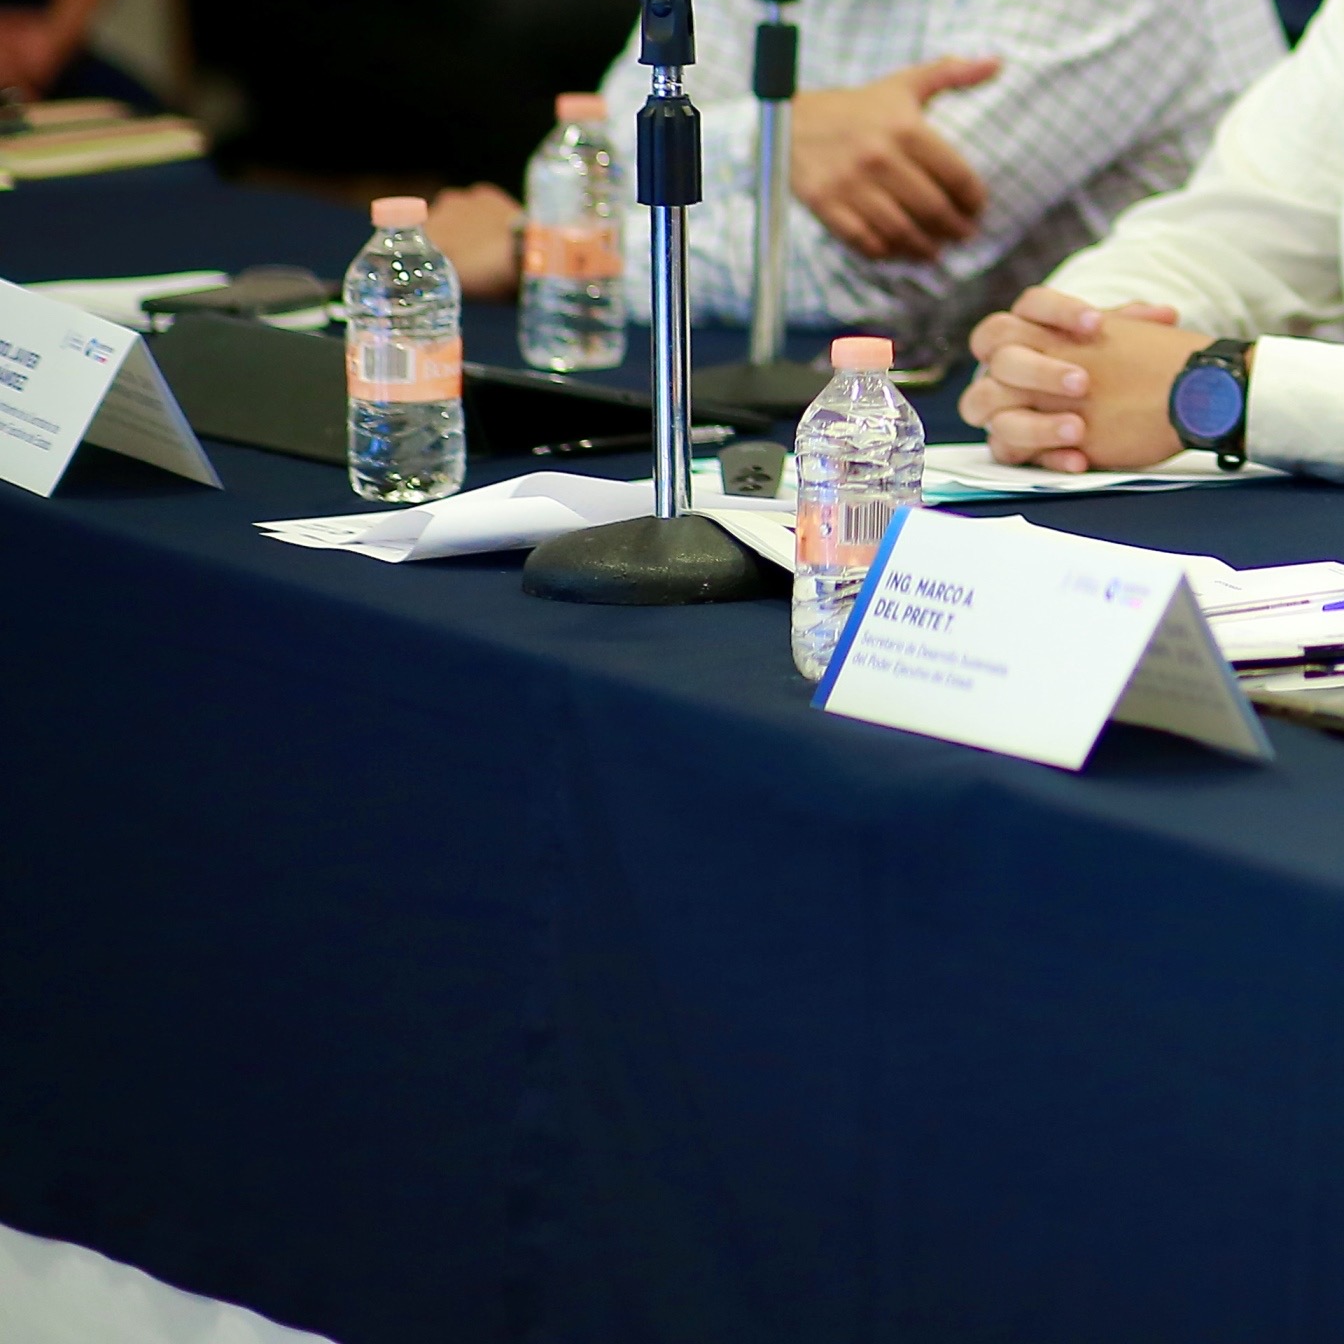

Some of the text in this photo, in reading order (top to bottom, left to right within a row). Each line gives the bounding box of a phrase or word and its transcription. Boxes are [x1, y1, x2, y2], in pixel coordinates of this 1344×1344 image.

[914, 577, 964, 604] MARCO
[874, 596, 899, 622] DEL
[902, 603, 946, 631] PRETE
